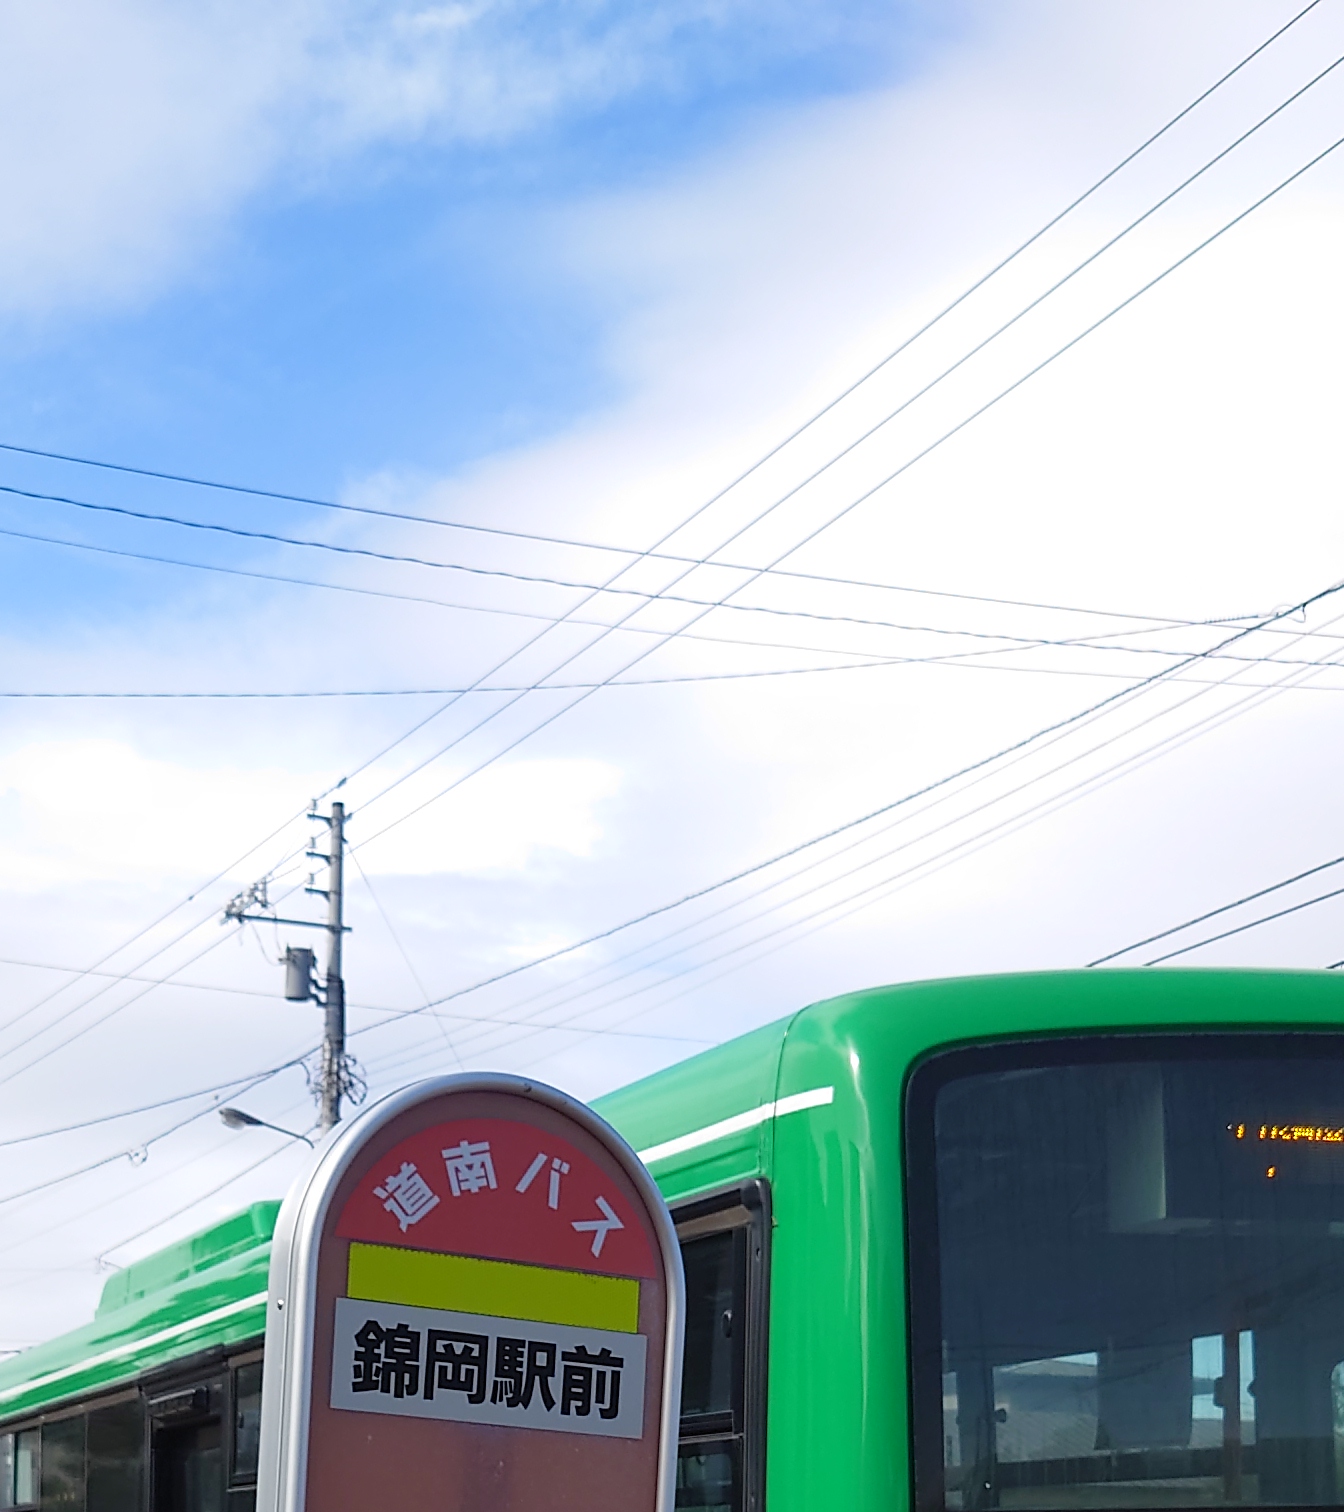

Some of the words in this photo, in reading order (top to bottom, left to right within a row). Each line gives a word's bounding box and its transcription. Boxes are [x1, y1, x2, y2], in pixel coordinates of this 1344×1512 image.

[373, 1140, 625, 1258] 道南バス
[351, 1320, 624, 1419] 錦岡駅前
